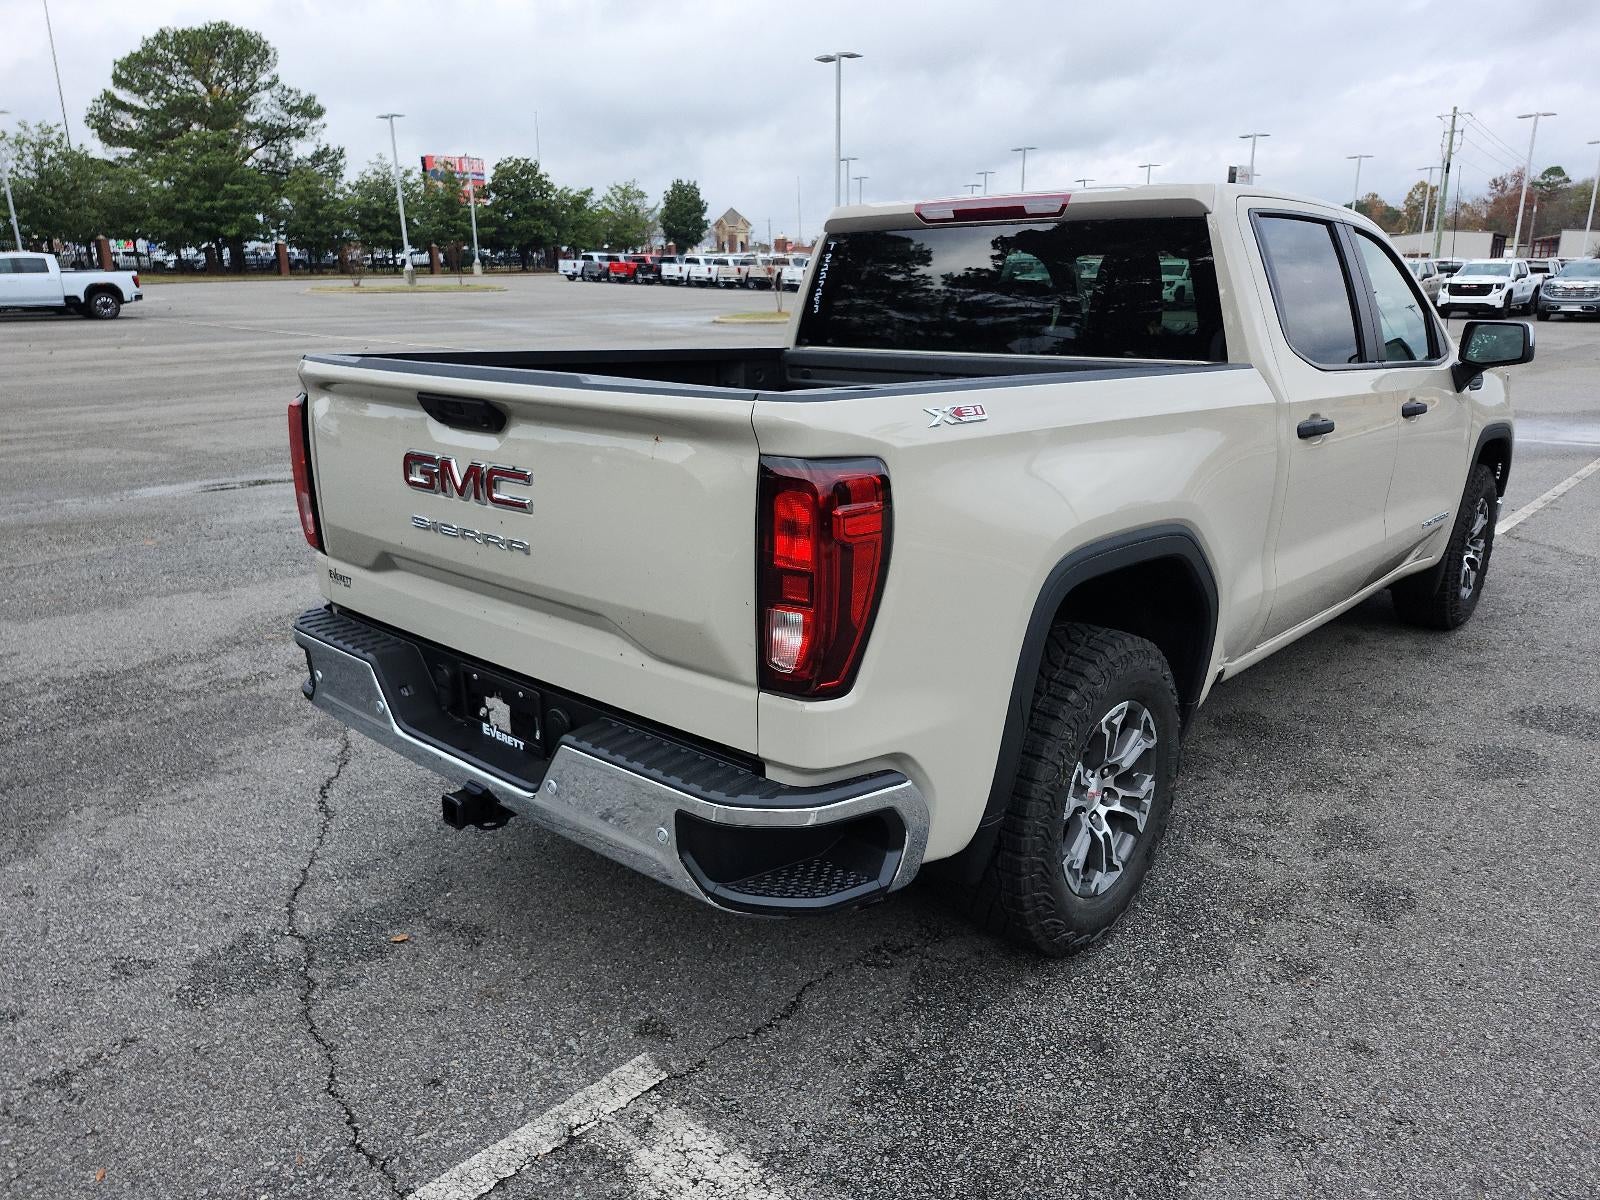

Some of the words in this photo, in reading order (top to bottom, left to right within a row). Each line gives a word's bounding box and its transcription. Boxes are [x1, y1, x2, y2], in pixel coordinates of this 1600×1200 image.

[922, 403, 989, 429] X31
[403, 449, 533, 514] GMC
[411, 515, 531, 555] SIERRA
[328, 568, 351, 584] EVERETT
[482, 722, 525, 750] EVERETT
